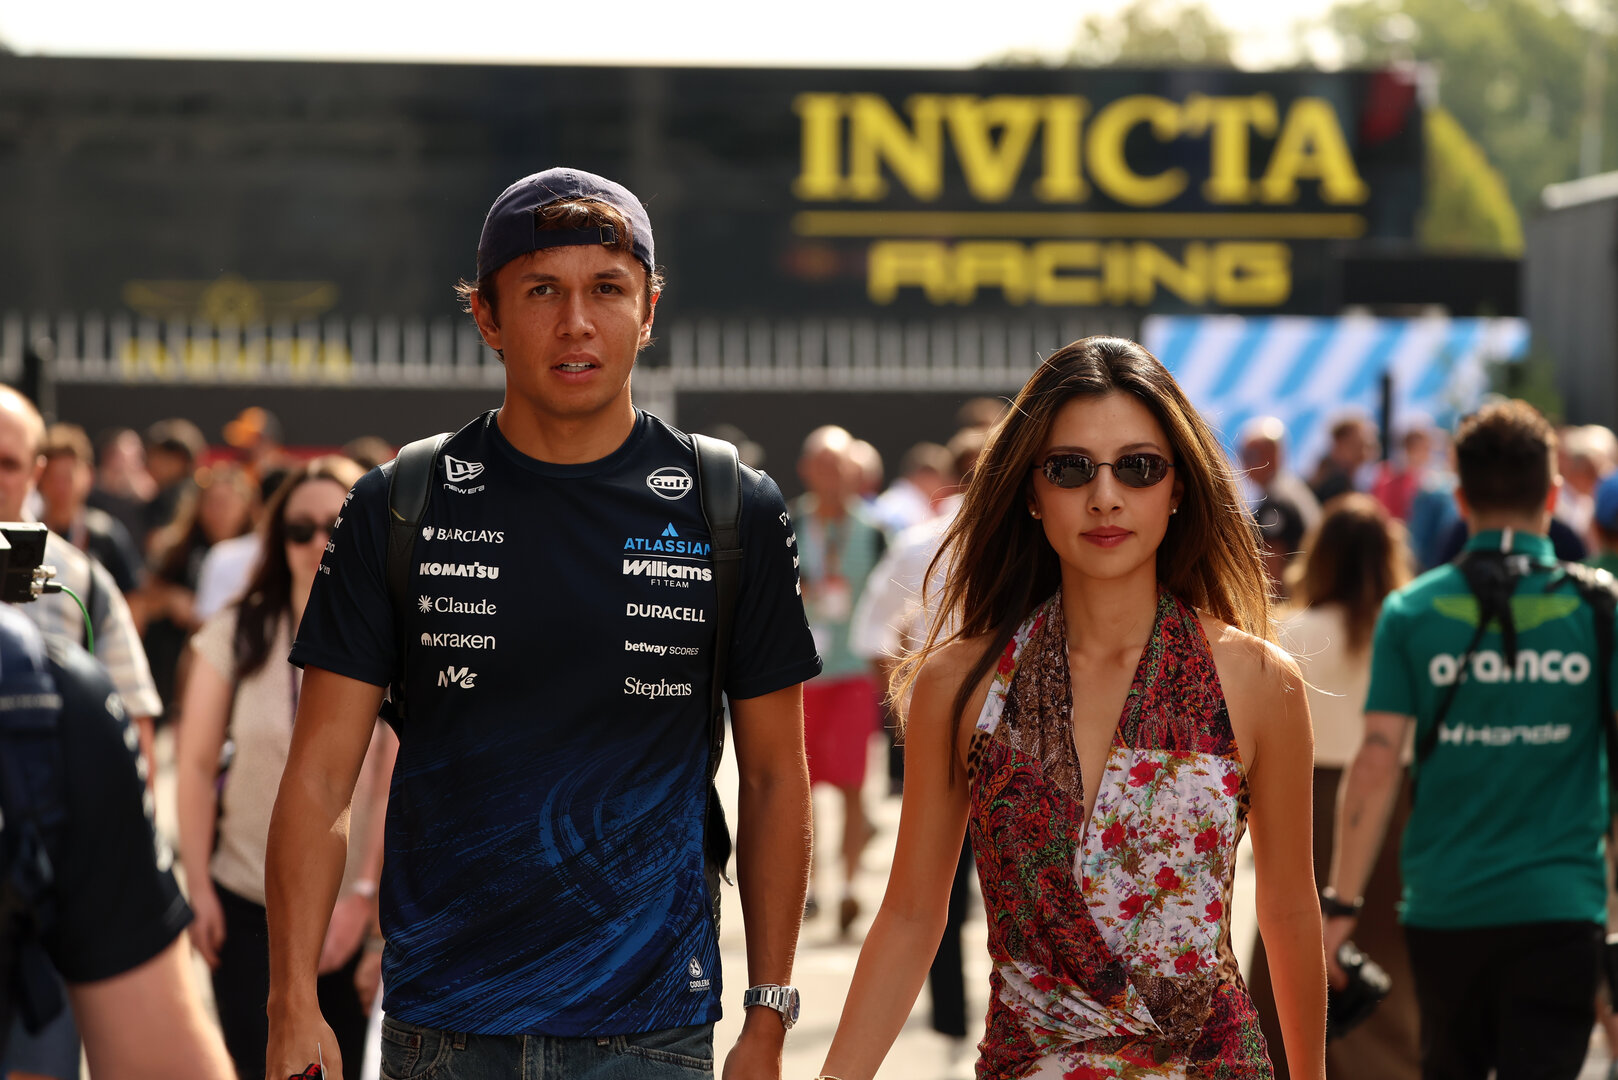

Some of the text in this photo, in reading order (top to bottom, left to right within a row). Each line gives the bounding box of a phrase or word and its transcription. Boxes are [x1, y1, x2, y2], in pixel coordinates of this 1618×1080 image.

[794, 93, 1368, 206] INVICTA
[867, 240, 1293, 305] RACING
[650, 478, 690, 487] Gulf
[436, 527, 505, 544] BARCLAYS
[419, 561, 500, 580] KOMATSU
[622, 559, 712, 582] Williams
[650, 578, 689, 589] F1 TEAM
[434, 596, 497, 616] Claude
[626, 603, 706, 623] DURACELL
[624, 640, 699, 657] betway SCORES
[623, 676, 692, 700] Stephens
